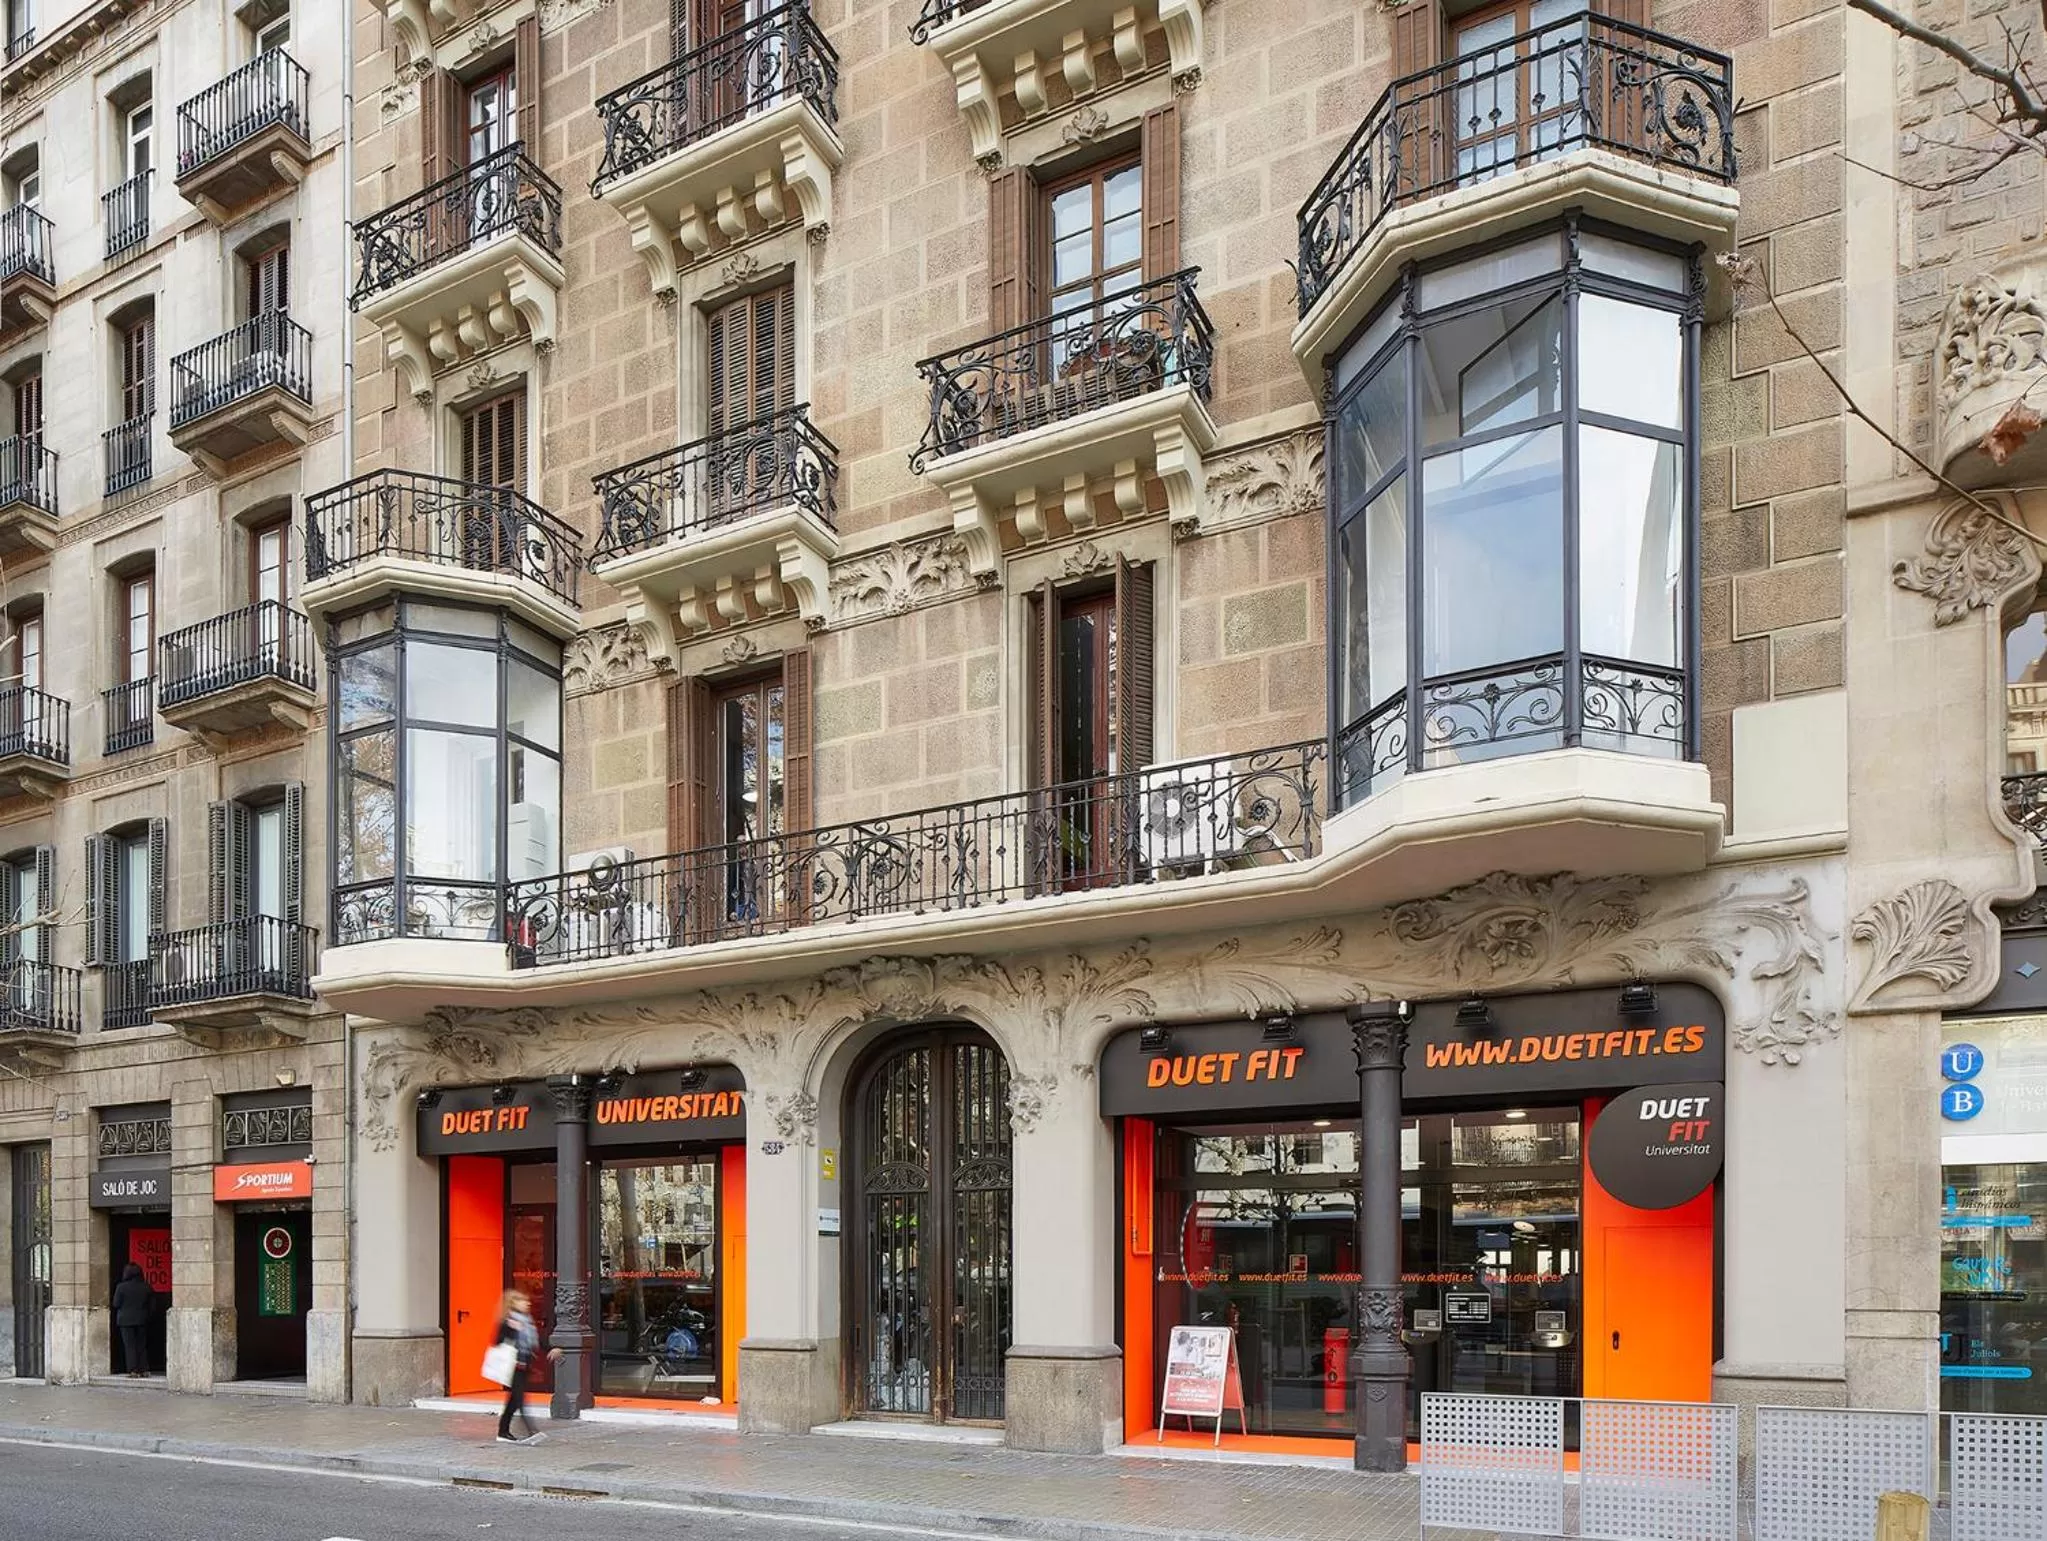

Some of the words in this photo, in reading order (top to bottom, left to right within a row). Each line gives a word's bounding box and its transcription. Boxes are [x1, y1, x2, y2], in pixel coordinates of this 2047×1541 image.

[1425, 1025, 1707, 1069] WWW.DUETFIT.ES
[1147, 1052, 1241, 1088] DUET
[1246, 1047, 1304, 1081] FIT
[1952, 1052, 1973, 1073] U
[597, 1090, 742, 1125] UNIVERSITAT
[1640, 1097, 1711, 1121] DUET
[1952, 1090, 1973, 1112] B
[441, 1109, 494, 1136] DUET
[497, 1106, 530, 1131] FIT
[1668, 1120, 1711, 1143] FIT
[1645, 1143, 1712, 1157] Universitat
[102, 1179, 125, 1197] SALÓ
[126, 1181, 139, 1196] DE
[140, 1180, 158, 1195] JOC
[231, 1171, 293, 1192] SPORTIUM
[146, 1255, 165, 1269] DE
[1238, 1272, 1308, 1284] www.duetfit.es
